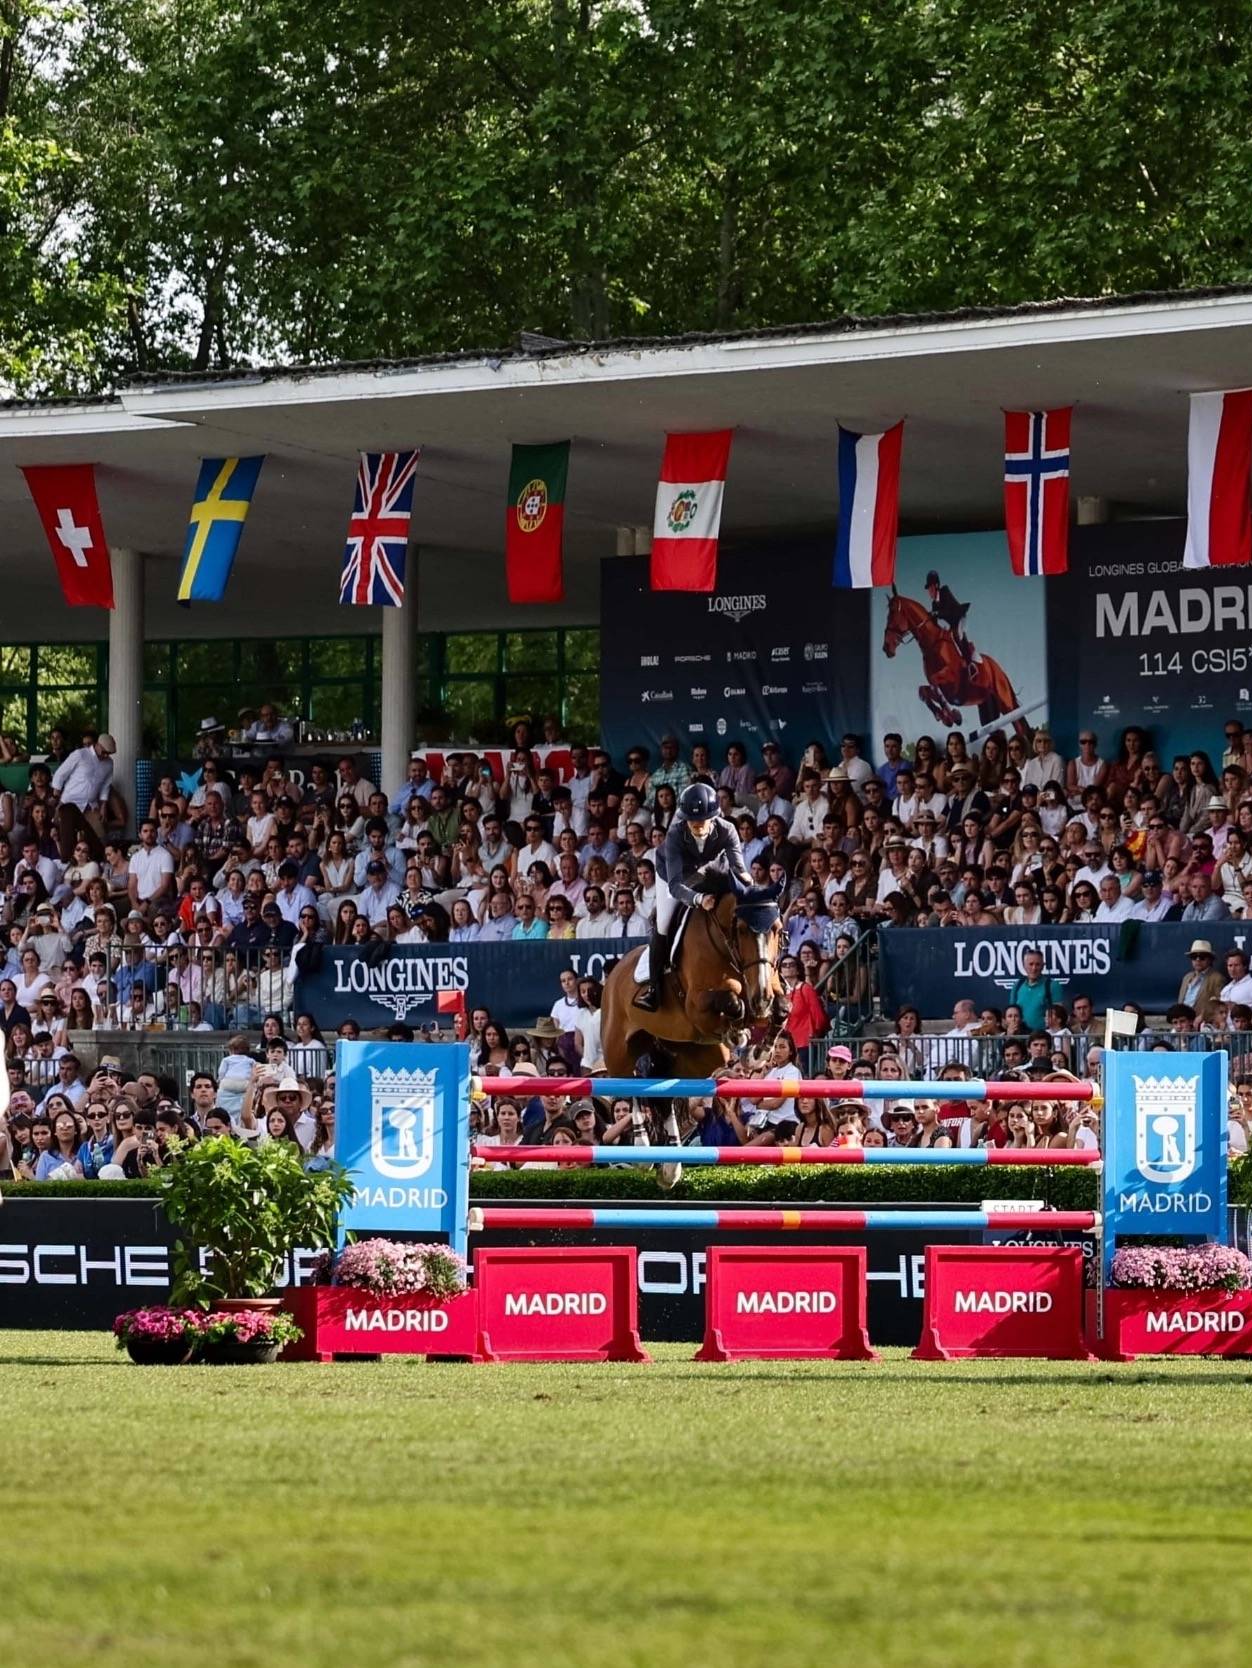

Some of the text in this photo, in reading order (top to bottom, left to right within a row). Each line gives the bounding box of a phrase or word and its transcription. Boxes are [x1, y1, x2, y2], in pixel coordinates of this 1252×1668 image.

[1089, 562, 1145, 577] LONGINES
[708, 595, 767, 612] LONGINES
[1139, 652, 1183, 676] 114
[334, 956, 469, 993] LONGINES
[352, 1186, 448, 1209] MADRID
[1119, 1192, 1212, 1213] MADRID
[505, 1292, 607, 1316] MADRID
[737, 1291, 837, 1313] MADRID
[955, 1290, 1053, 1313] MADRID
[345, 1308, 449, 1333] MADRID
[1146, 1311, 1245, 1333] MADRID
